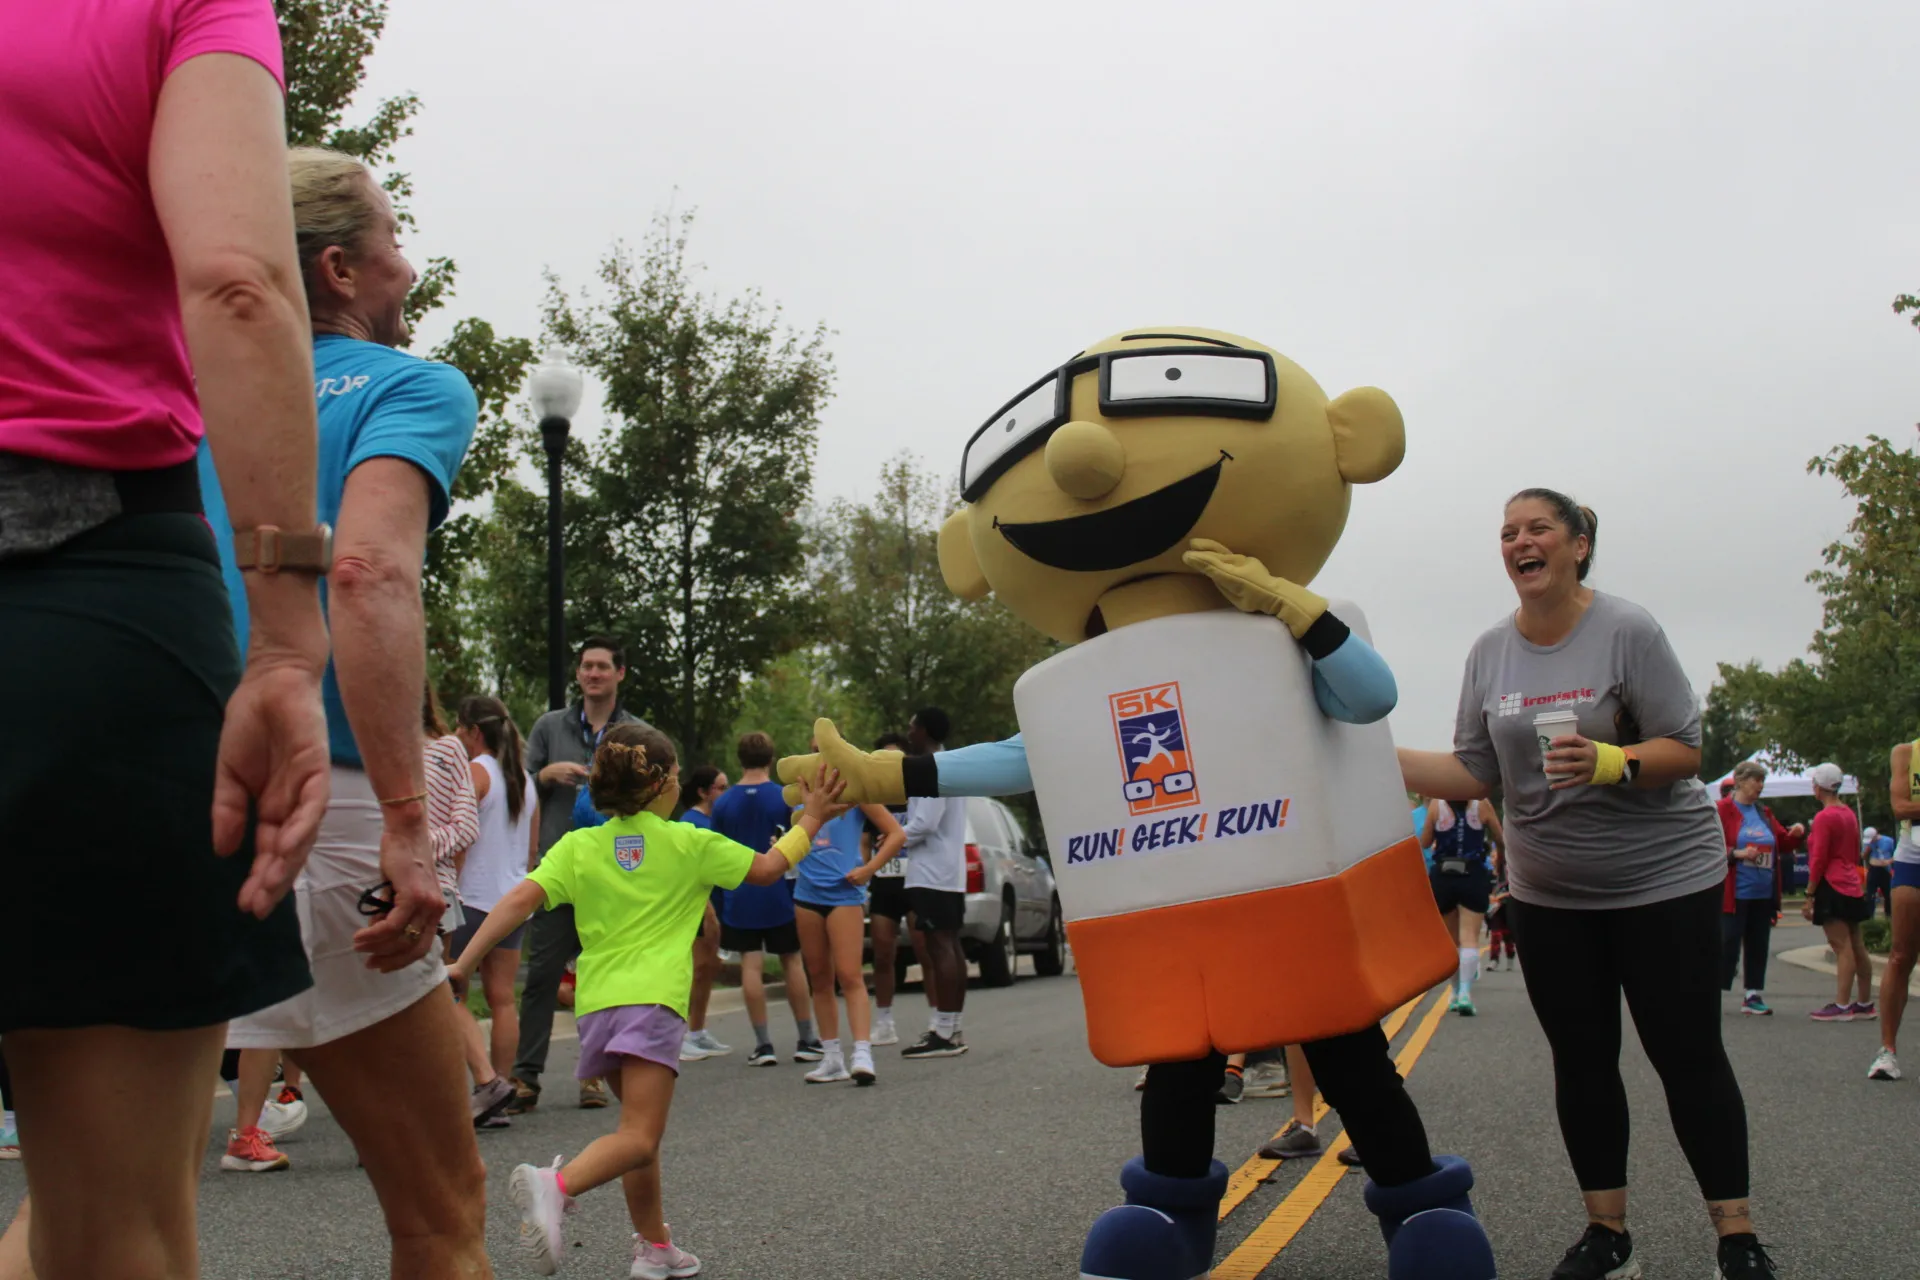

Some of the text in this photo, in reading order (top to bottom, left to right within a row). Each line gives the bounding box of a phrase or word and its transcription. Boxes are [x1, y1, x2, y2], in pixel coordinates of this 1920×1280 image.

[316, 375, 370, 398] TOR
[1116, 687, 1176, 719] 5K
[1067, 798, 1290, 864] RUN! GEEK! RUN!
